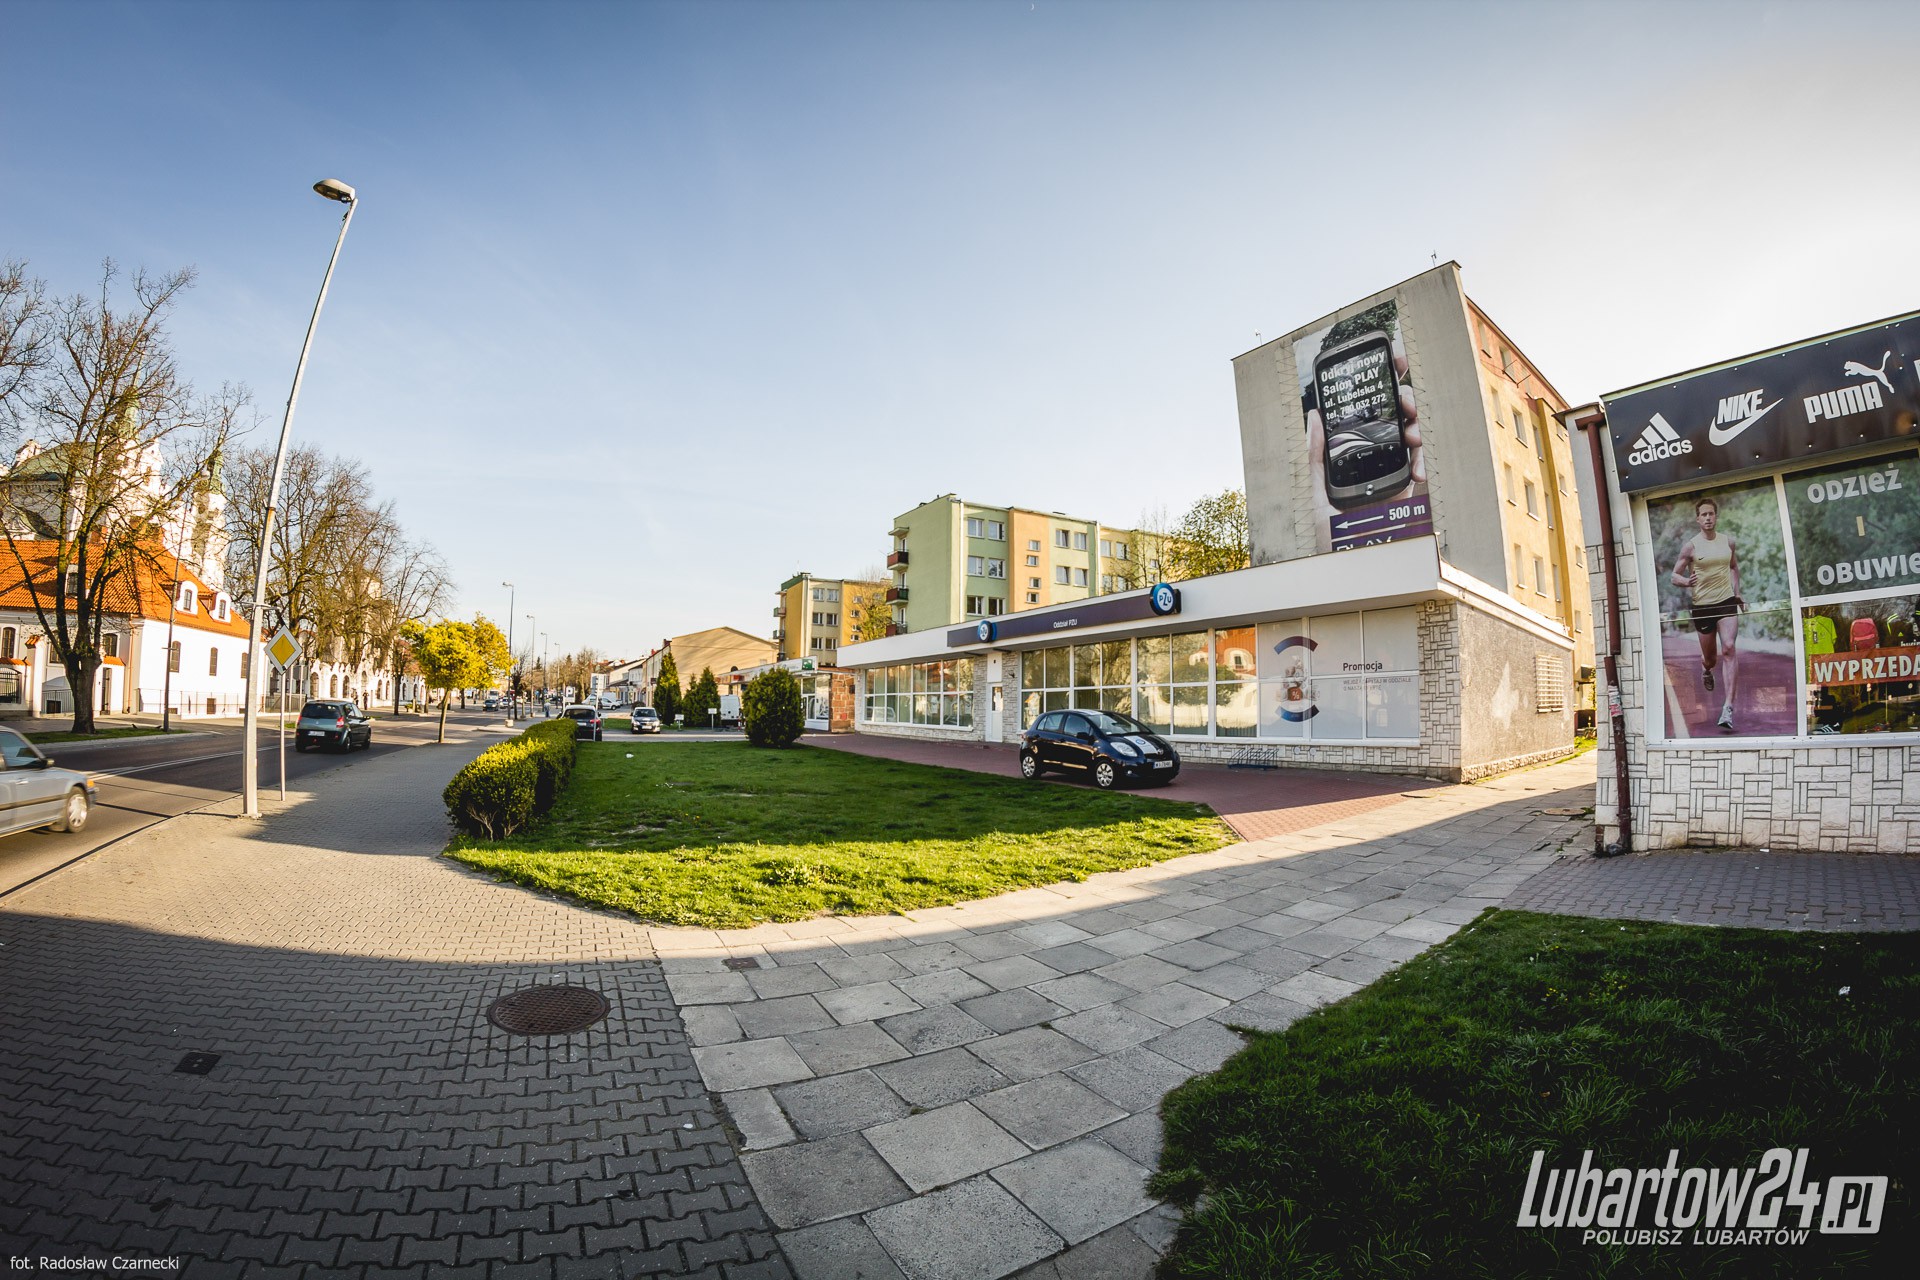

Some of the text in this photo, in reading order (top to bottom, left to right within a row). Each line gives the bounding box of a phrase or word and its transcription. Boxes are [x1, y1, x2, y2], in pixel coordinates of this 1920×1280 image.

[1357, 352, 1385, 368] nowy
[1323, 367, 1379, 396] Salon PLAY
[1325, 381, 1384, 409] ul. Lubelska 4
[1371, 393, 1387, 405] 272
[1717, 388, 1764, 424] NIKE
[1803, 381, 1883, 424] PUMA
[1628, 438, 1693, 466] adidas
[1389, 504, 1425, 520] 500 m
[1159, 592, 1171, 606] PZU
[1343, 661, 1383, 672] Promocja
